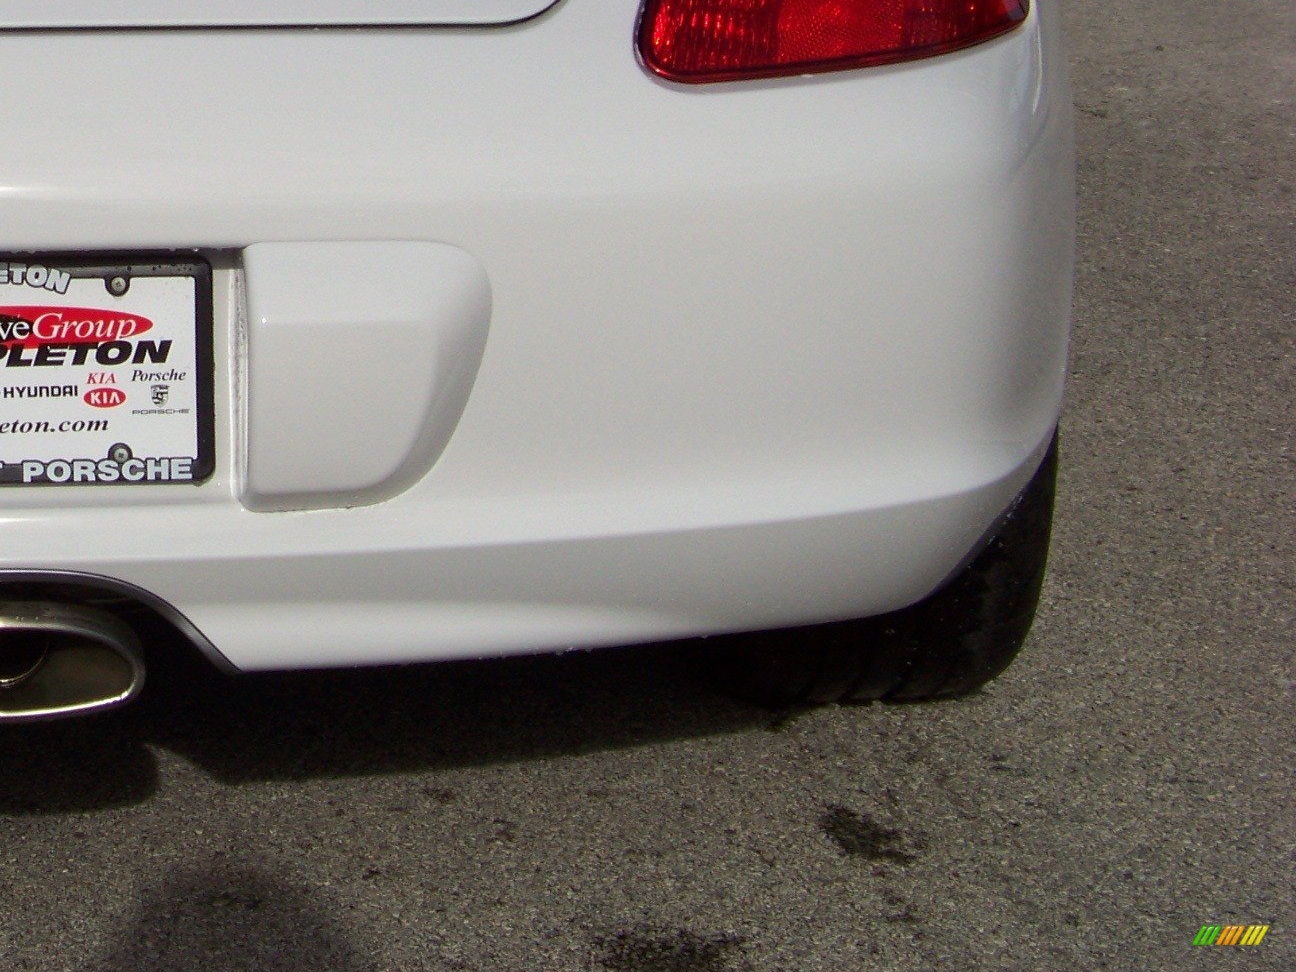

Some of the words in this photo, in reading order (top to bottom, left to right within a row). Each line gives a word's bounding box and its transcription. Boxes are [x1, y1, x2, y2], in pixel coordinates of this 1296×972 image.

[32, 312, 136, 341] Group
[86, 372, 116, 384] KIA
[131, 369, 186, 382] Porsche
[3, 385, 79, 399] HYUNDAI
[90, 392, 120, 405] KIA
[22, 458, 193, 482] PORSCHE
